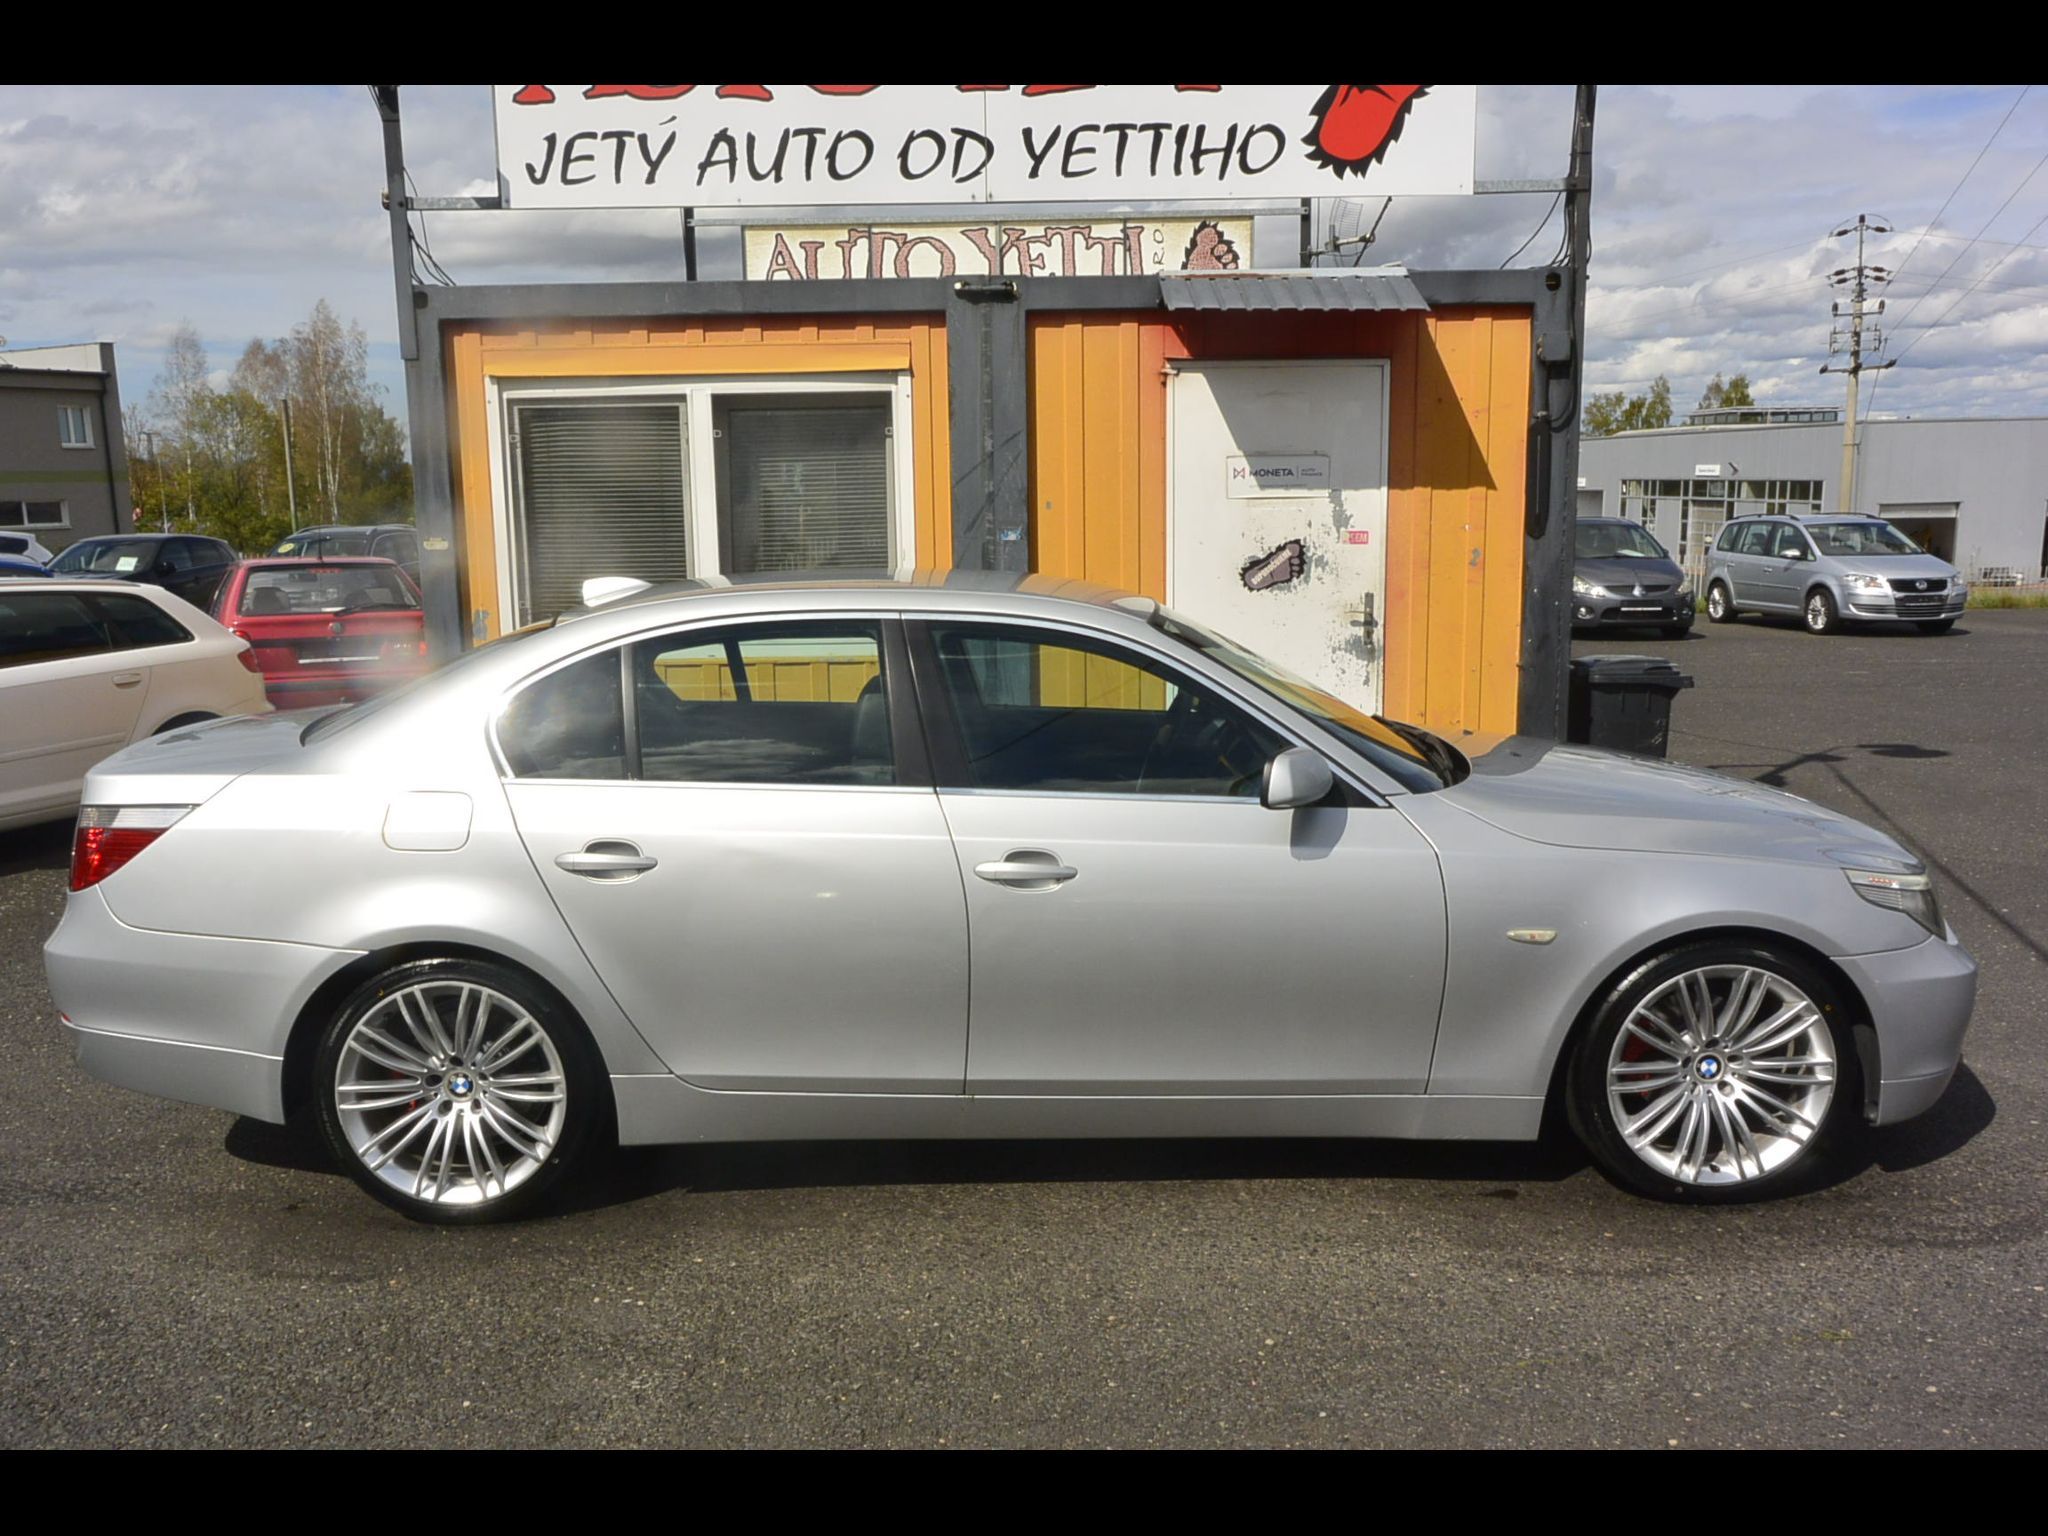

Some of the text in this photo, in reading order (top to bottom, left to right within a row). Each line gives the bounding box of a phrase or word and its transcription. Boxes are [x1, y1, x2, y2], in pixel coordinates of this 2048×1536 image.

[525, 116, 1287, 186] JETÝ AUTO OD YETTIHO
[766, 225, 1145, 281] AUTO YETTI
[1248, 468, 1295, 478] MONETA
